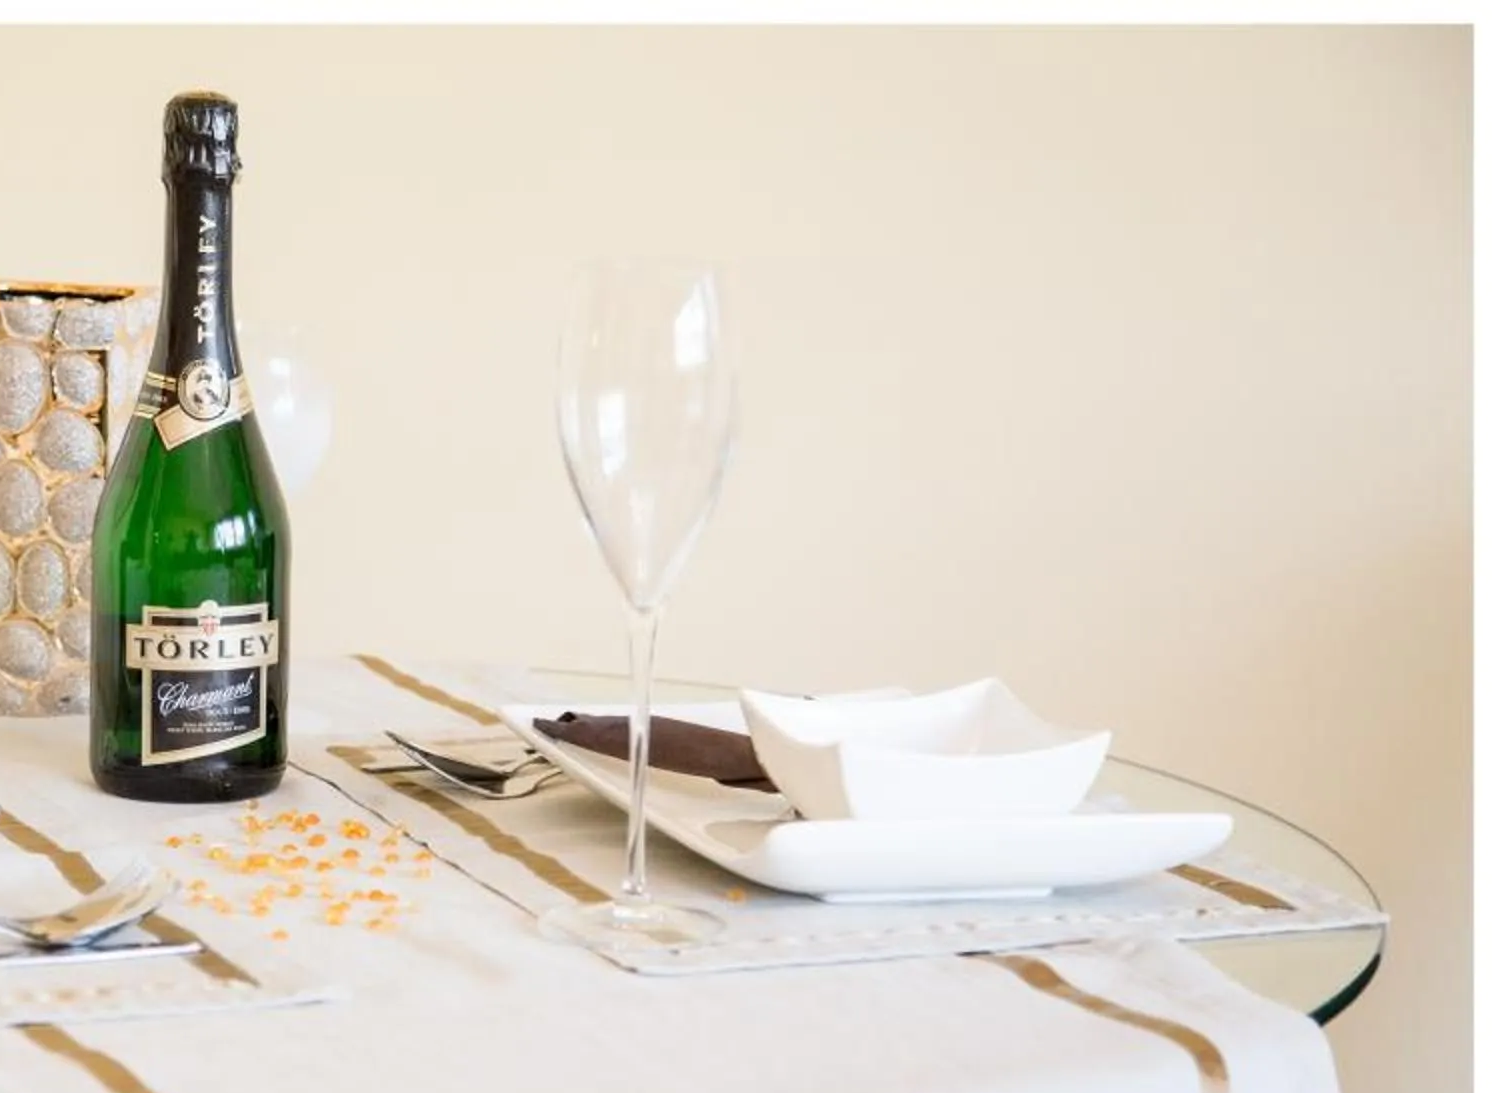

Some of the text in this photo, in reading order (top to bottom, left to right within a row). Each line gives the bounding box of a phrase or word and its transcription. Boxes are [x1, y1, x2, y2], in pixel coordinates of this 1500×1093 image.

[193, 214, 217, 344] TÖRLEY
[134, 633, 275, 660] TÖRLEY
[157, 672, 254, 717] Charmant
